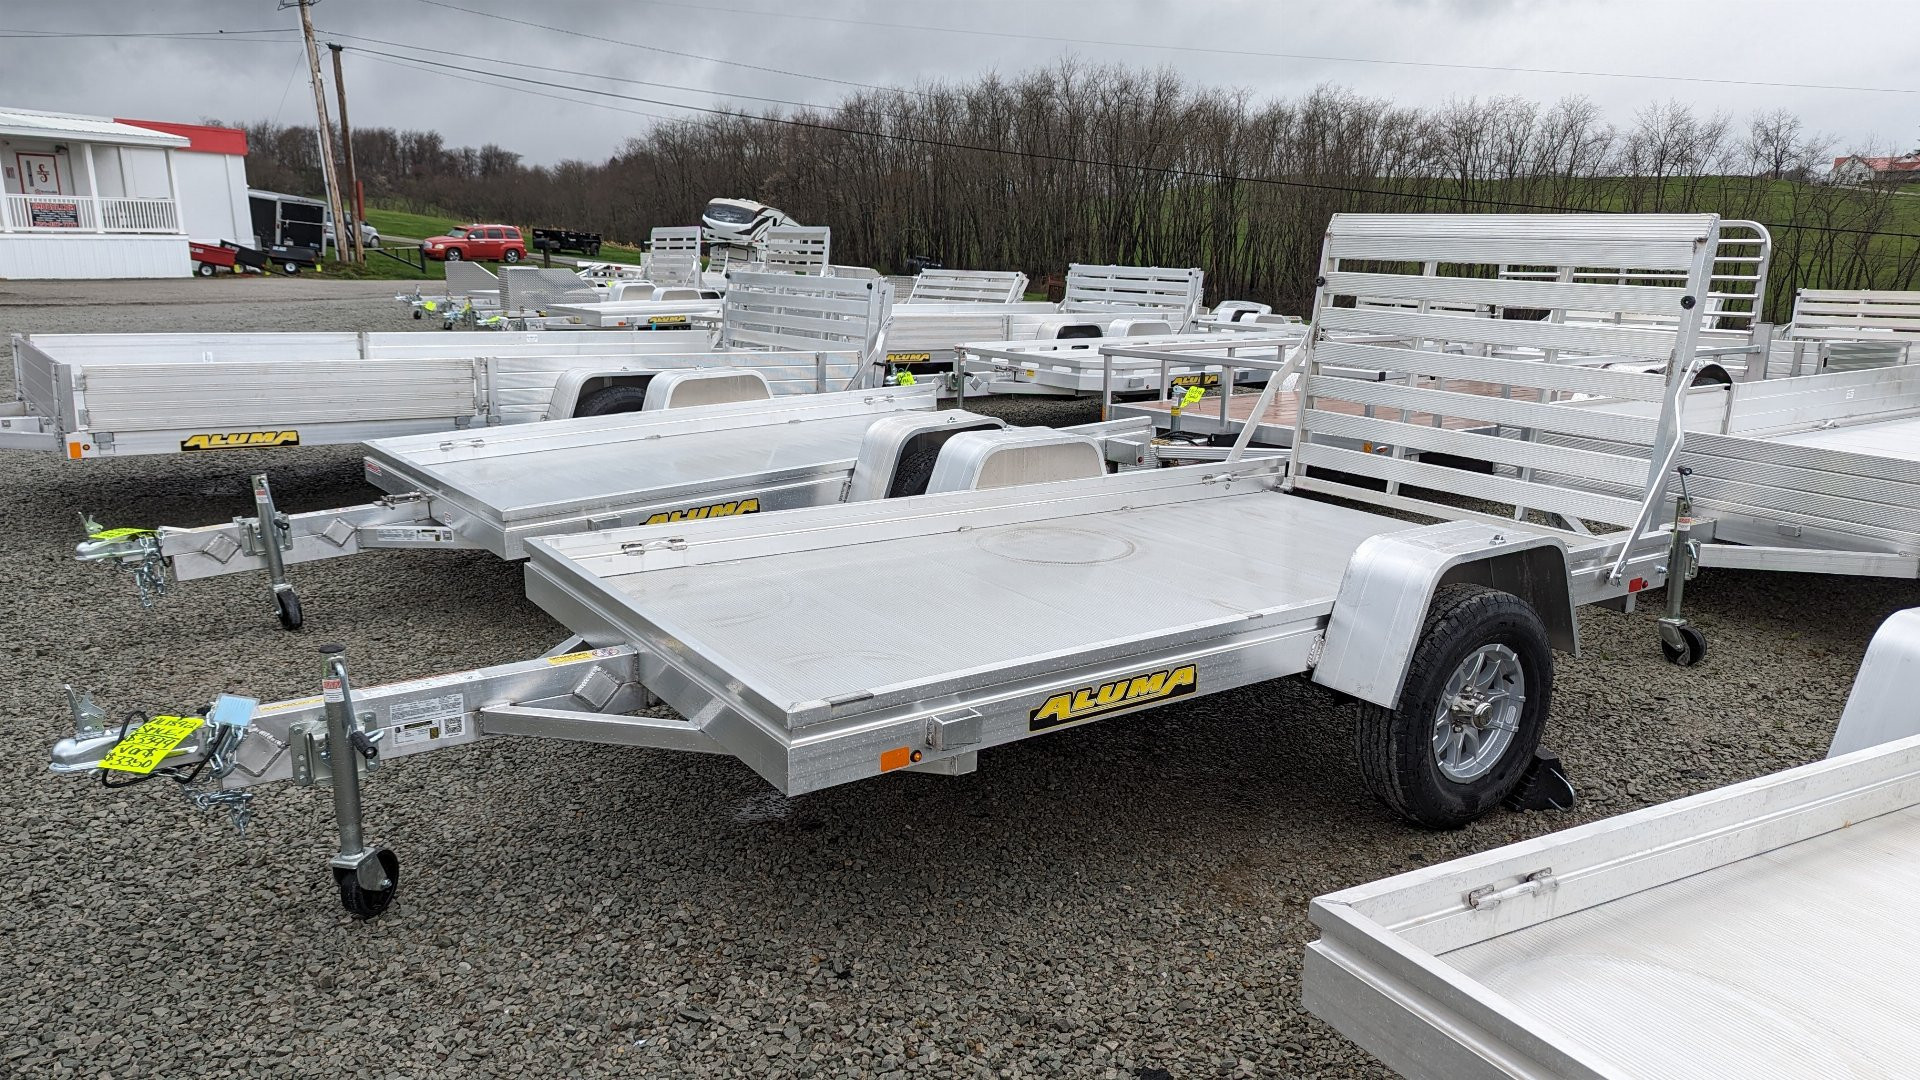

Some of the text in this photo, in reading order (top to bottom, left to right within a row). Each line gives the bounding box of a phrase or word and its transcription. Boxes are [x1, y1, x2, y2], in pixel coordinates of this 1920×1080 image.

[886, 353, 930, 363] ALUMA
[182, 430, 299, 450] ALUMA
[640, 498, 760, 525] ALUMA
[1032, 664, 1196, 722] ALUMA
[104, 751, 153, 769] $3350
